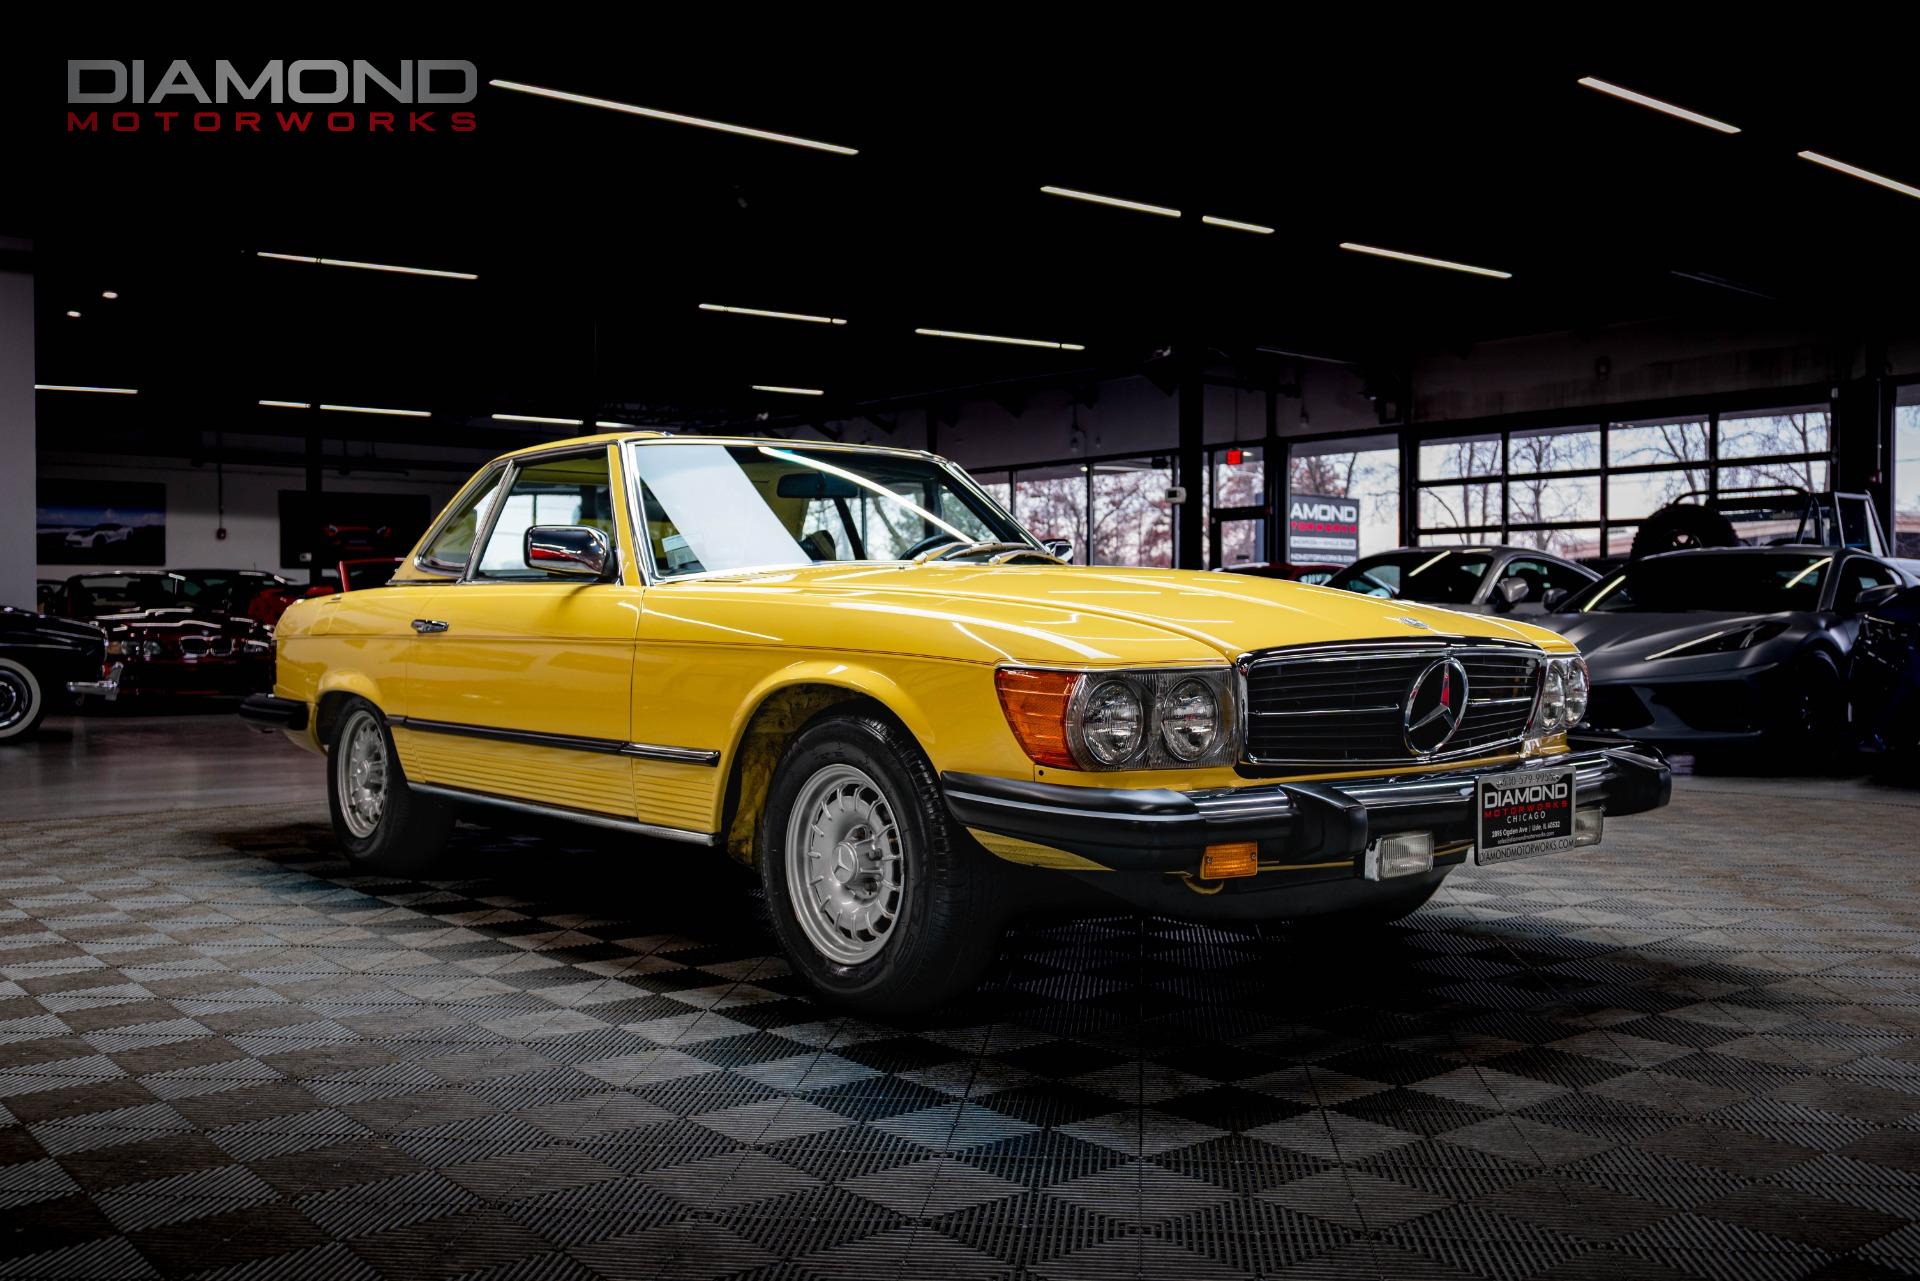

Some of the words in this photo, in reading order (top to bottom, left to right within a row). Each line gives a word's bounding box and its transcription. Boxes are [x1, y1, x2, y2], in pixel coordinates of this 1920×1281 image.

[1290, 502, 1357, 522] AMOND
[1484, 783, 1568, 808] DIAMOND
[1483, 800, 1568, 817] MOTORWORKS
[1507, 811, 1546, 824] CHICAGO
